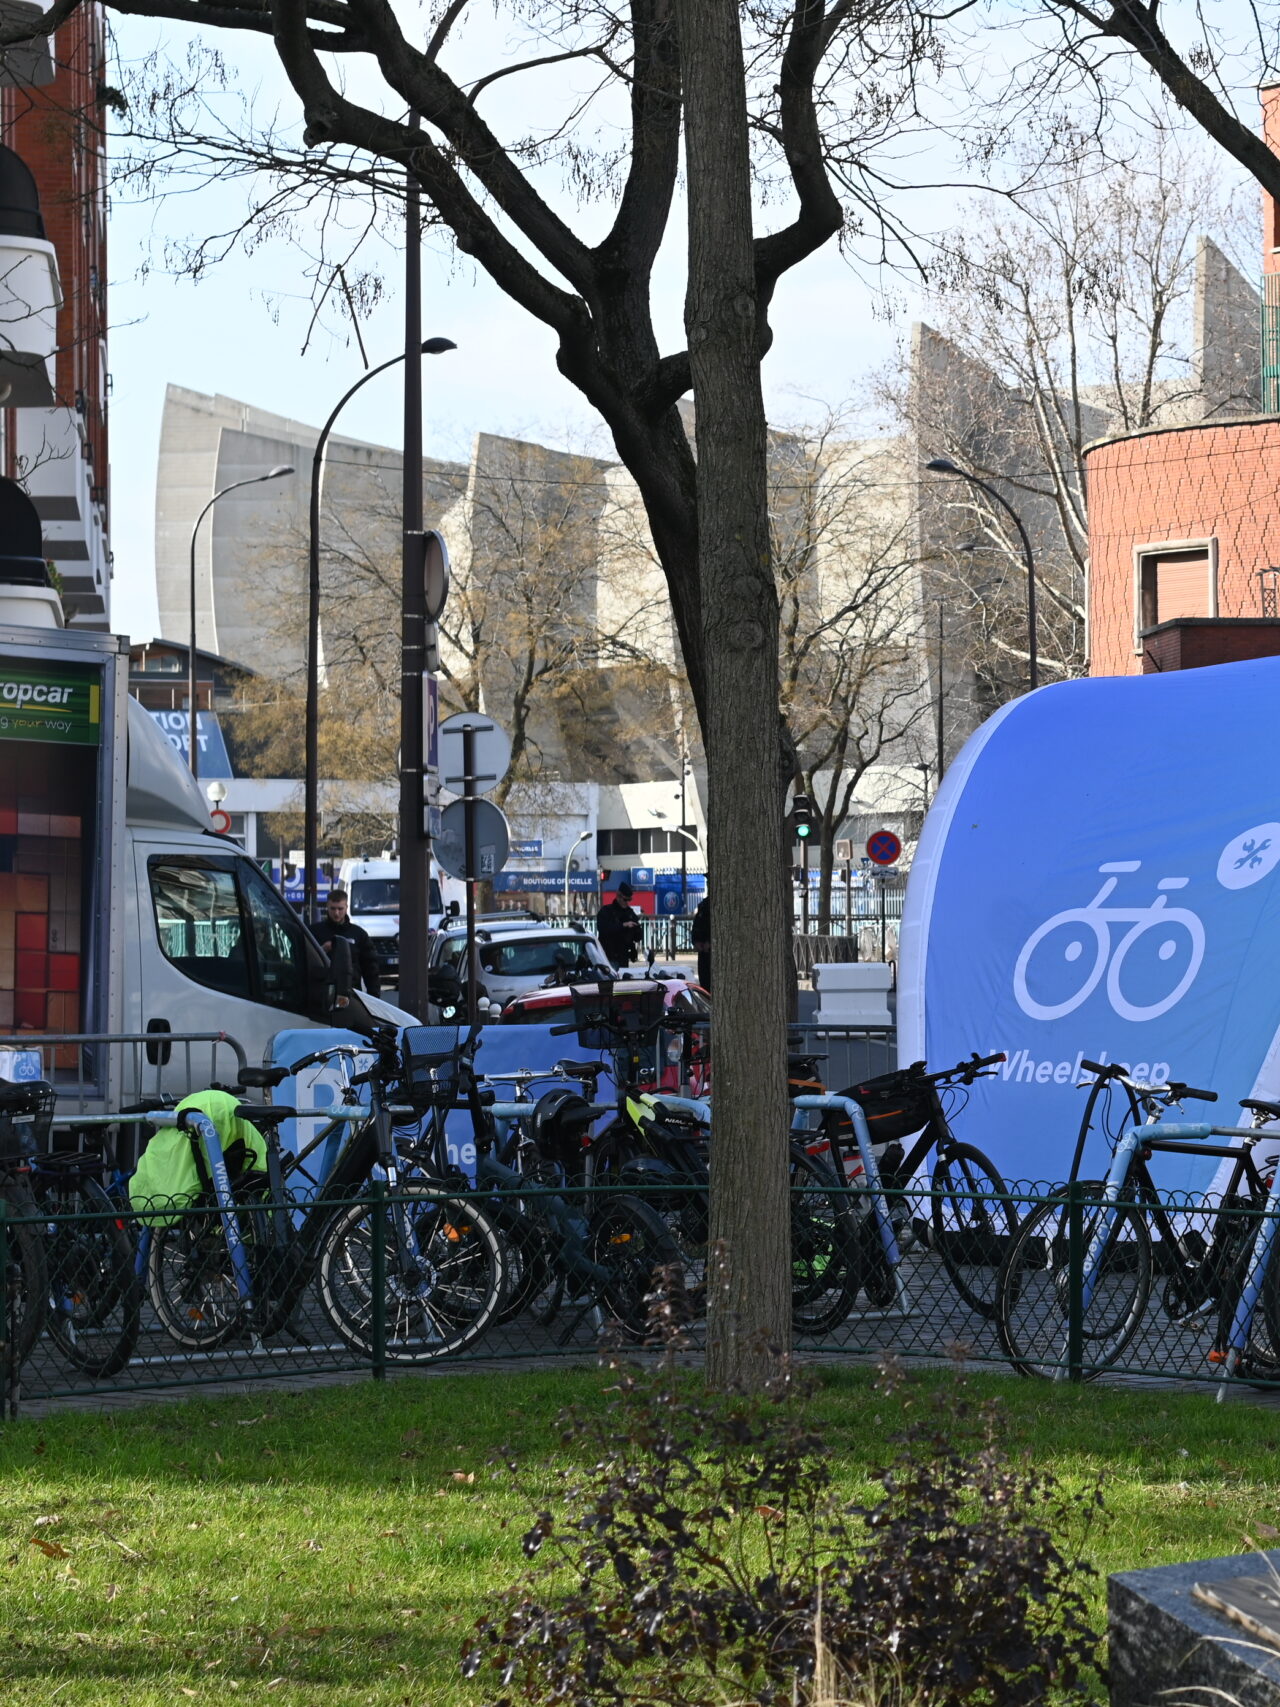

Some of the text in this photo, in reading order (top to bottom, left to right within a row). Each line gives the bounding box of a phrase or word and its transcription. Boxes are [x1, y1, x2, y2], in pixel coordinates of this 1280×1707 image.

[45, 720, 72, 734] way
[523, 878, 592, 886] BOUTIQUE OFICIELLE
